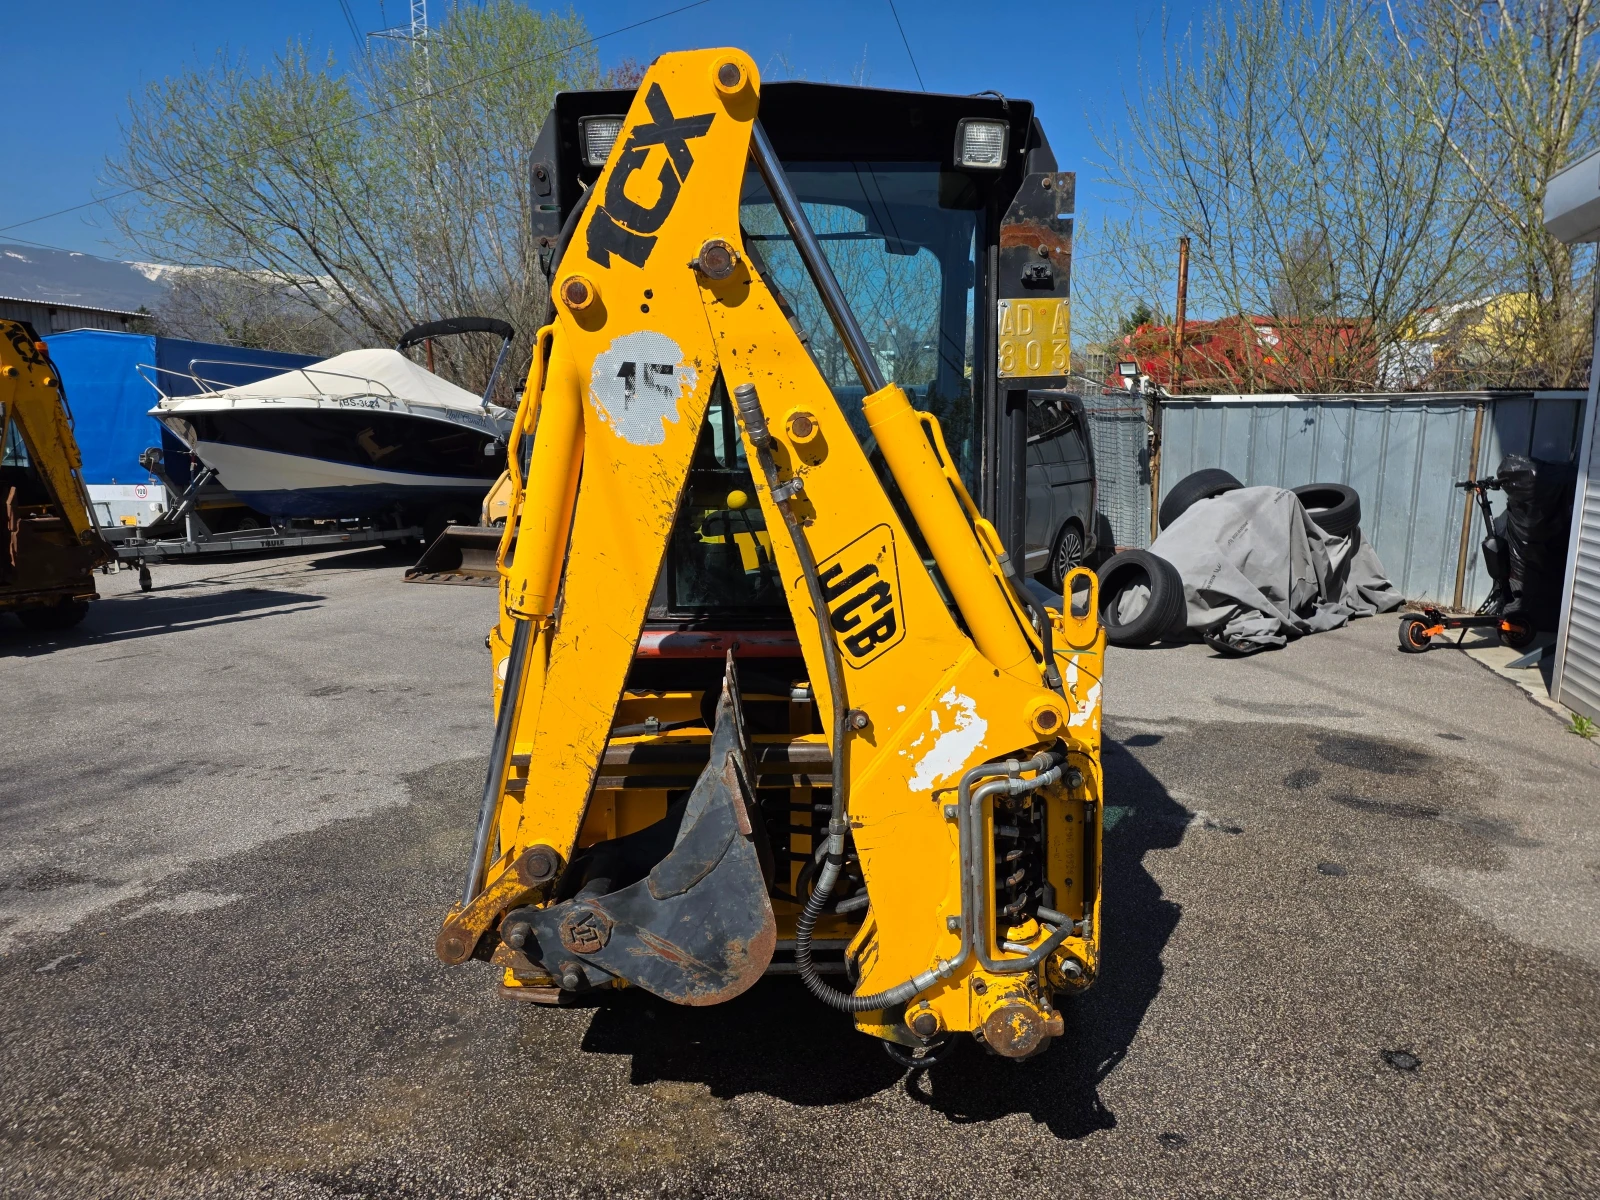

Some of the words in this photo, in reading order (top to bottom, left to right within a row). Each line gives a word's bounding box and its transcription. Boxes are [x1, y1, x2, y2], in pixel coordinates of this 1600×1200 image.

[586, 81, 716, 269] 1CX
[1001, 304, 1033, 336] AD
[1052, 303, 1069, 335] A
[1000, 339, 1067, 372] 803
[817, 562, 897, 658] JCB
